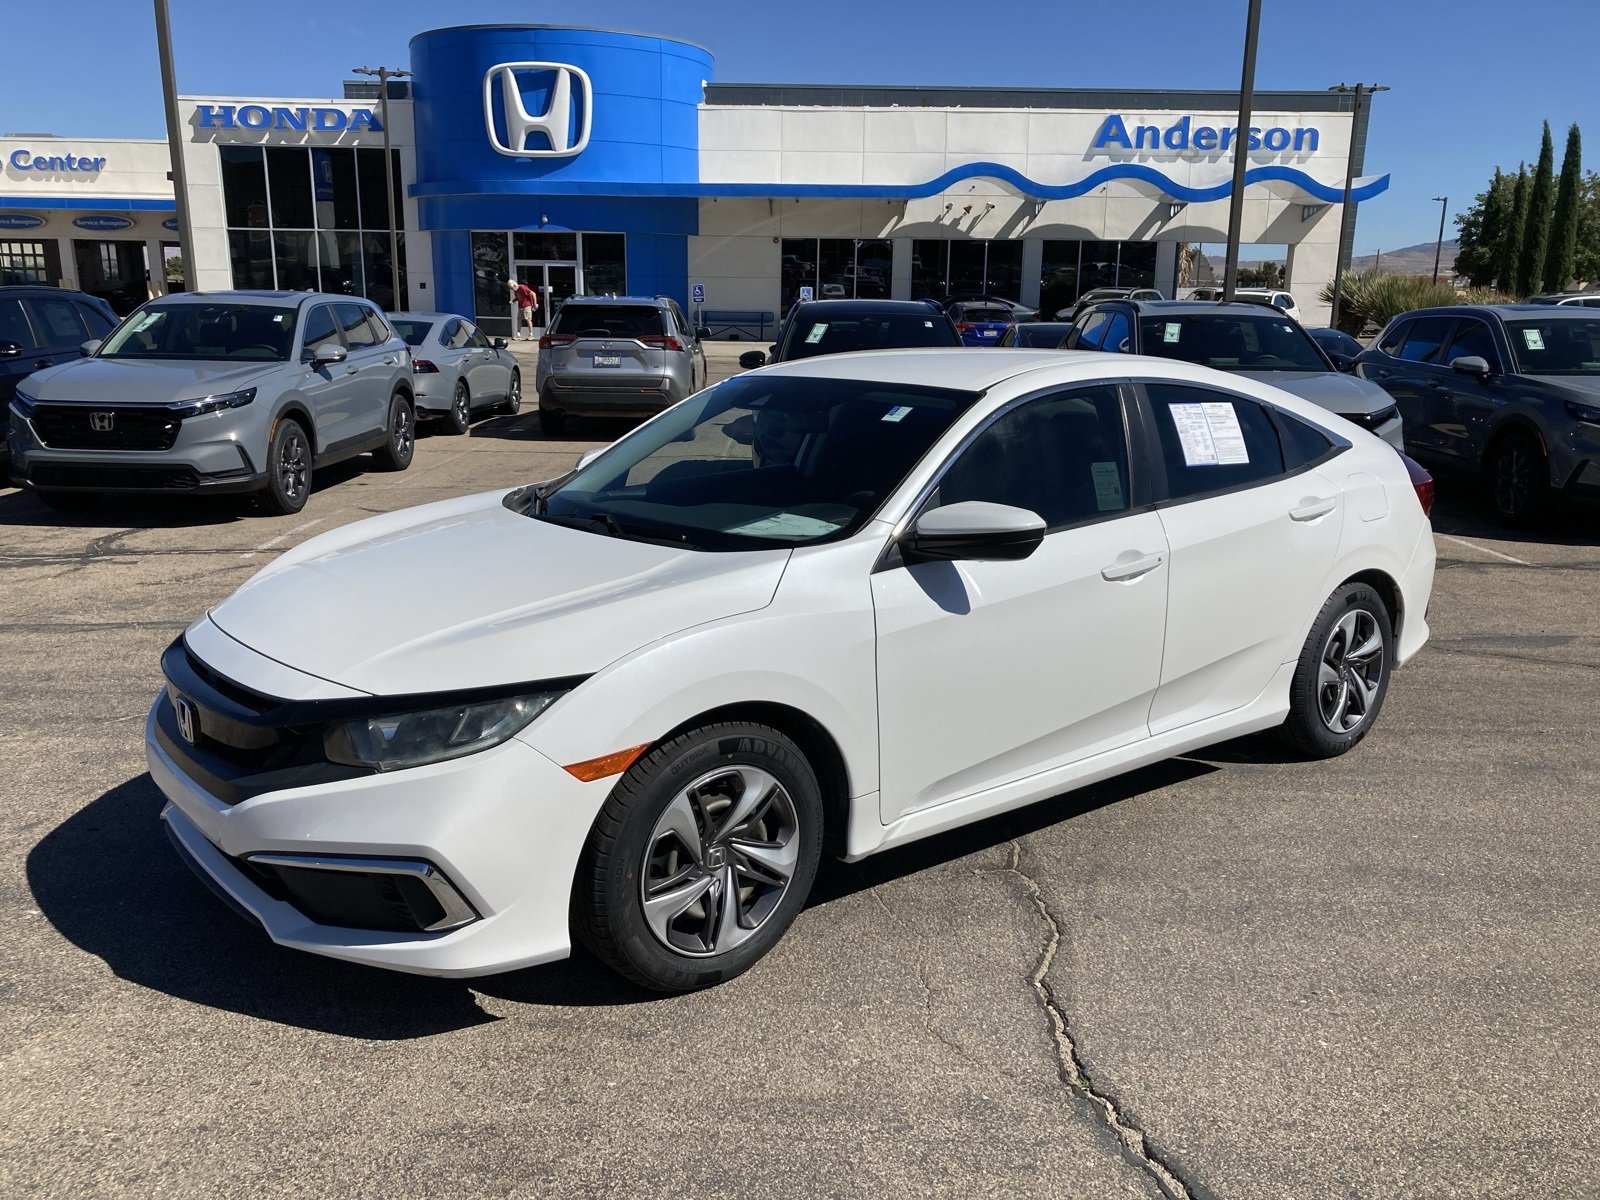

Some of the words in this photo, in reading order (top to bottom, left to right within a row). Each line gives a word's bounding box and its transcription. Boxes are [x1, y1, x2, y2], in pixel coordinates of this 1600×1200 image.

[196, 104, 385, 132] HONDA
[1094, 114, 1319, 151] Anderson
[10, 150, 106, 172] Center
